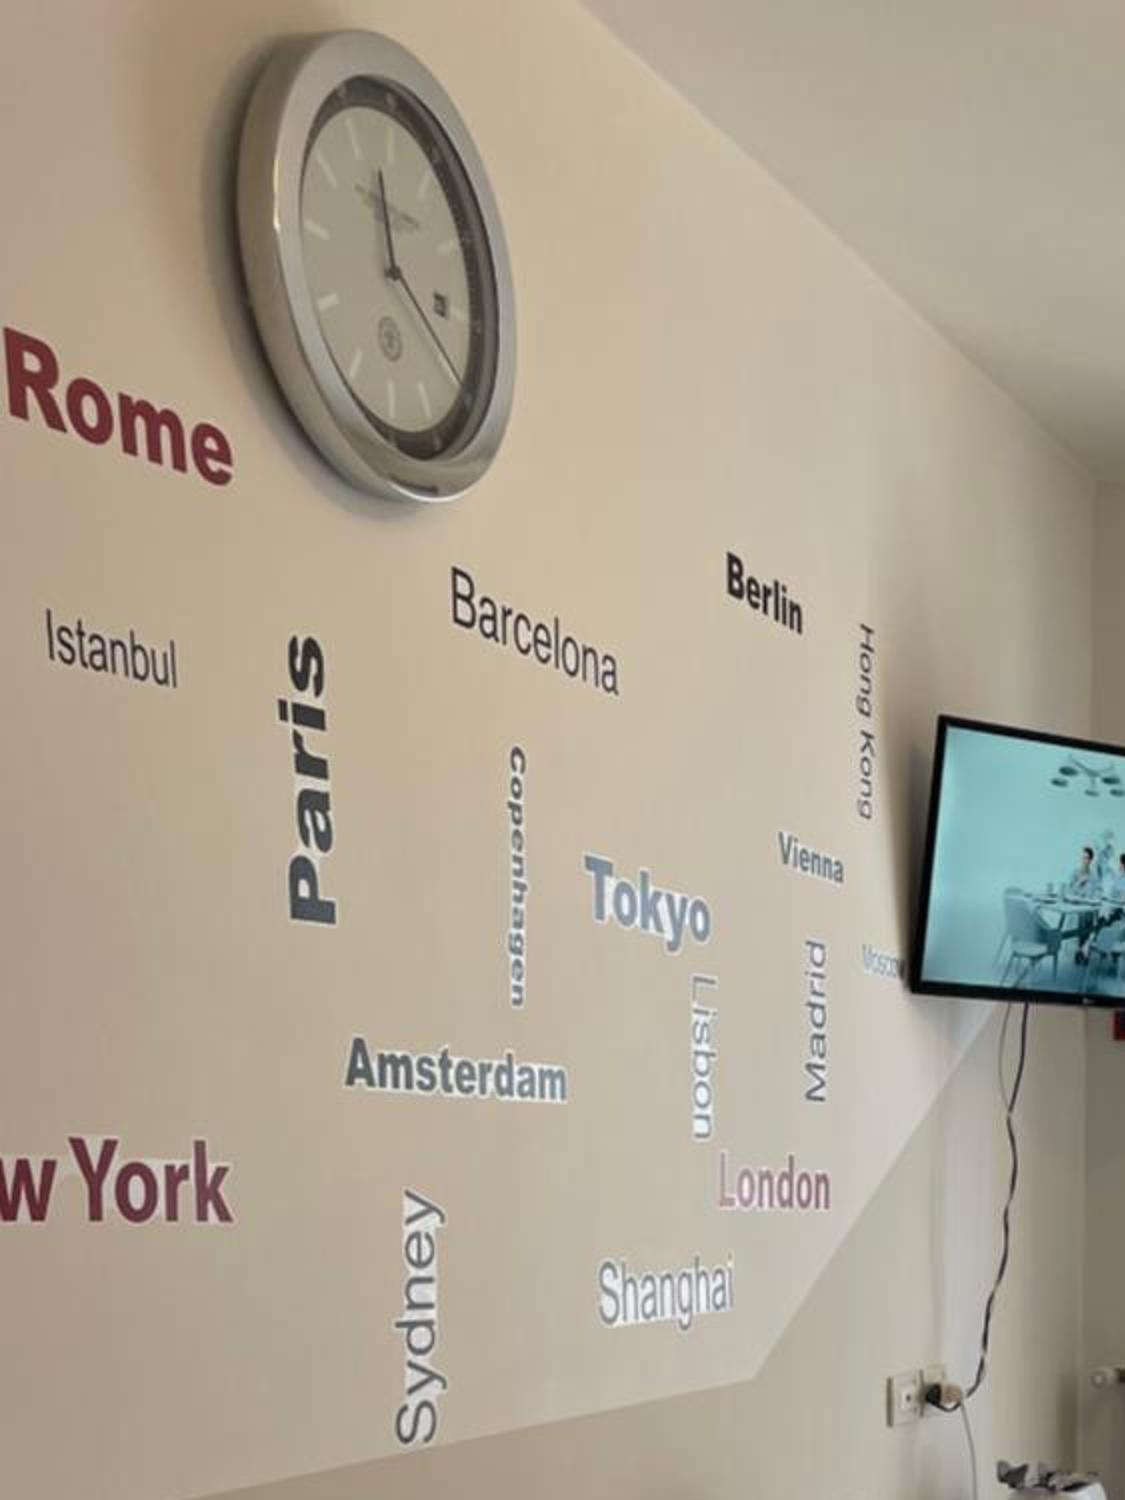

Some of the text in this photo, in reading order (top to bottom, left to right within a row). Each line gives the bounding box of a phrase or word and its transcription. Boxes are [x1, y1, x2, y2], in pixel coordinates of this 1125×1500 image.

[3, 326, 234, 486] Rome
[451, 566, 619, 696] Barcelona
[726, 551, 803, 635] Berlin
[46, 608, 178, 689] Istanbul
[855, 622, 876, 820] Hong Kong
[277, 634, 337, 925] Paris
[506, 746, 529, 1007] Copenhagen
[584, 854, 711, 953] Tokyo
[777, 831, 845, 884] Vienna
[863, 944, 906, 979] Mosco
[345, 1036, 567, 1100] Amsterdam
[692, 975, 718, 1140] Lisbon
[804, 939, 828, 1102] Madrid
[67, 1136, 234, 1223] York
[719, 1151, 831, 1210] London
[394, 1189, 448, 1445] Sydney
[599, 1252, 735, 1332] Shanghai
